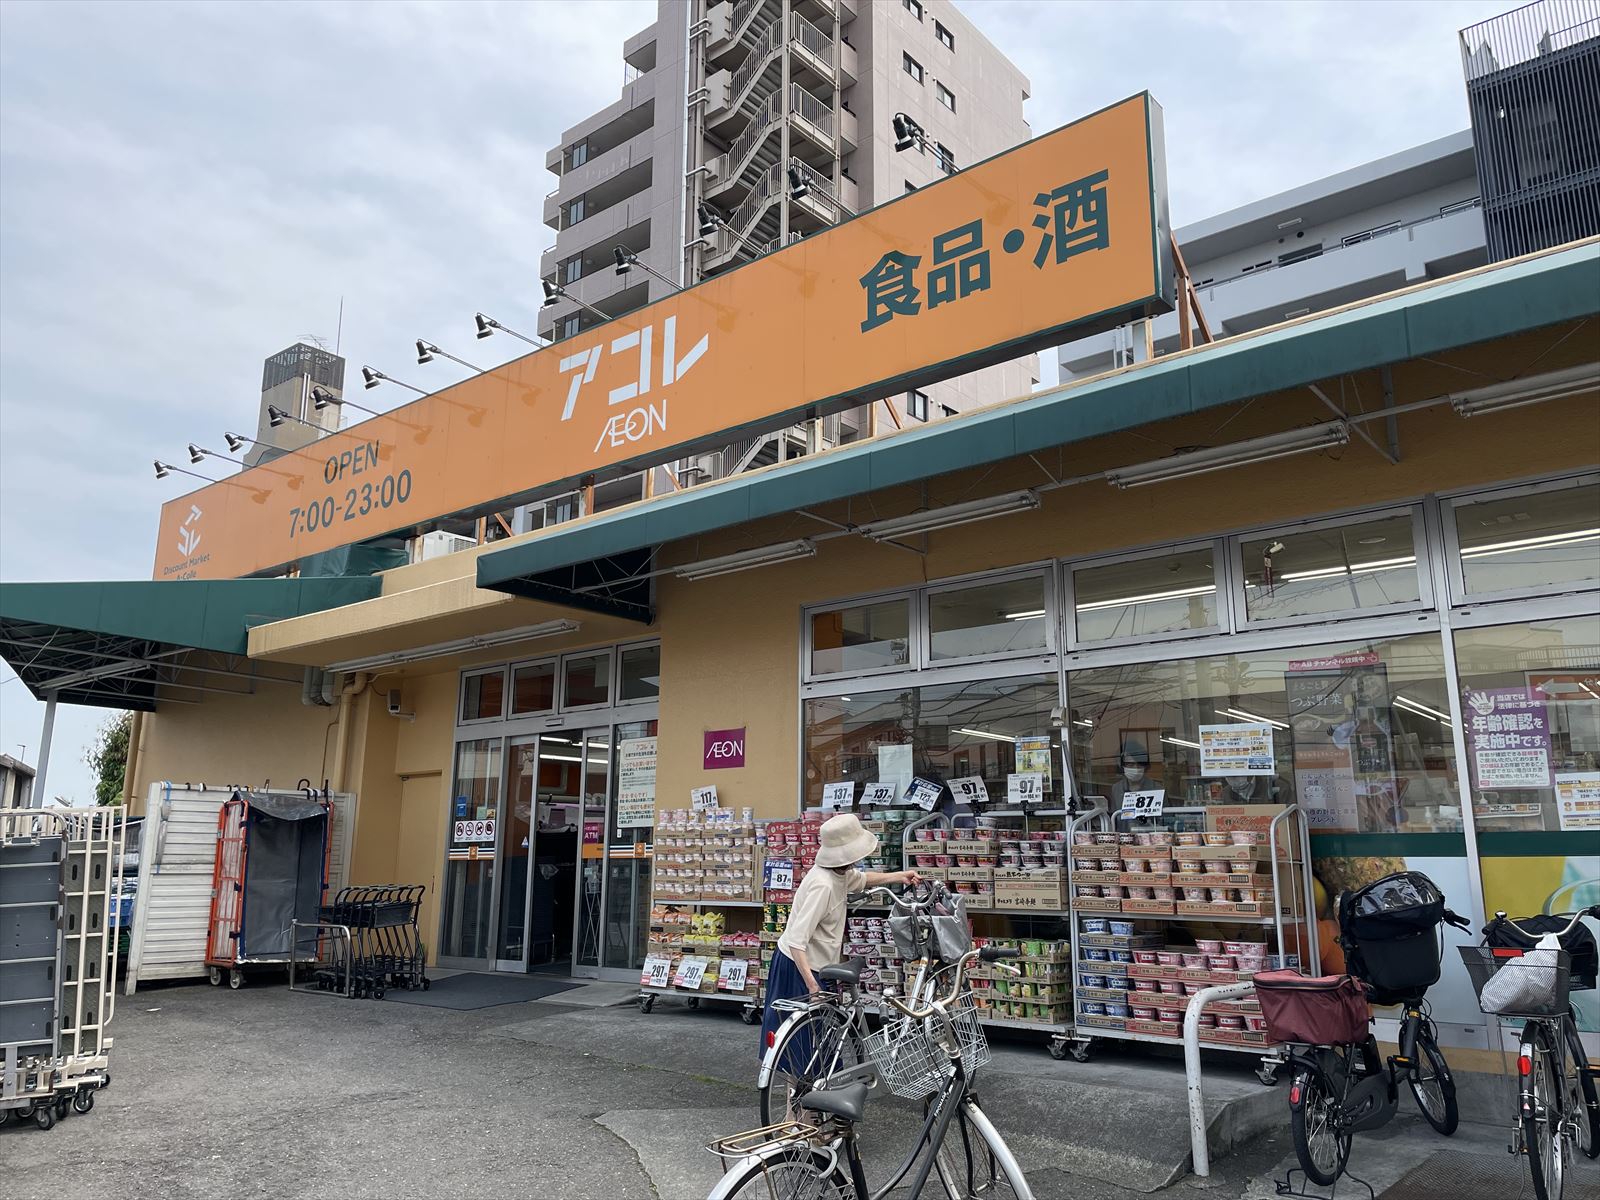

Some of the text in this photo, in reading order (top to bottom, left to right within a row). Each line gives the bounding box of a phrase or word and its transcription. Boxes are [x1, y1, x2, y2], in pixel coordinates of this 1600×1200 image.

[859, 168, 1110, 334] 食品・酒
[559, 315, 709, 422] アコレ
[324, 440, 380, 485] OPEN
[289, 469, 412, 539] 7:00-23:00
[163, 553, 210, 576] Discount Market
[1497, 694, 1526, 702] 当店では
[1498, 700, 1541, 711] 法律に基づき
[1472, 713, 1544, 733] 年齢確認を
[1474, 732, 1547, 750] 実施中です。
[584, 832, 599, 840] ATM
